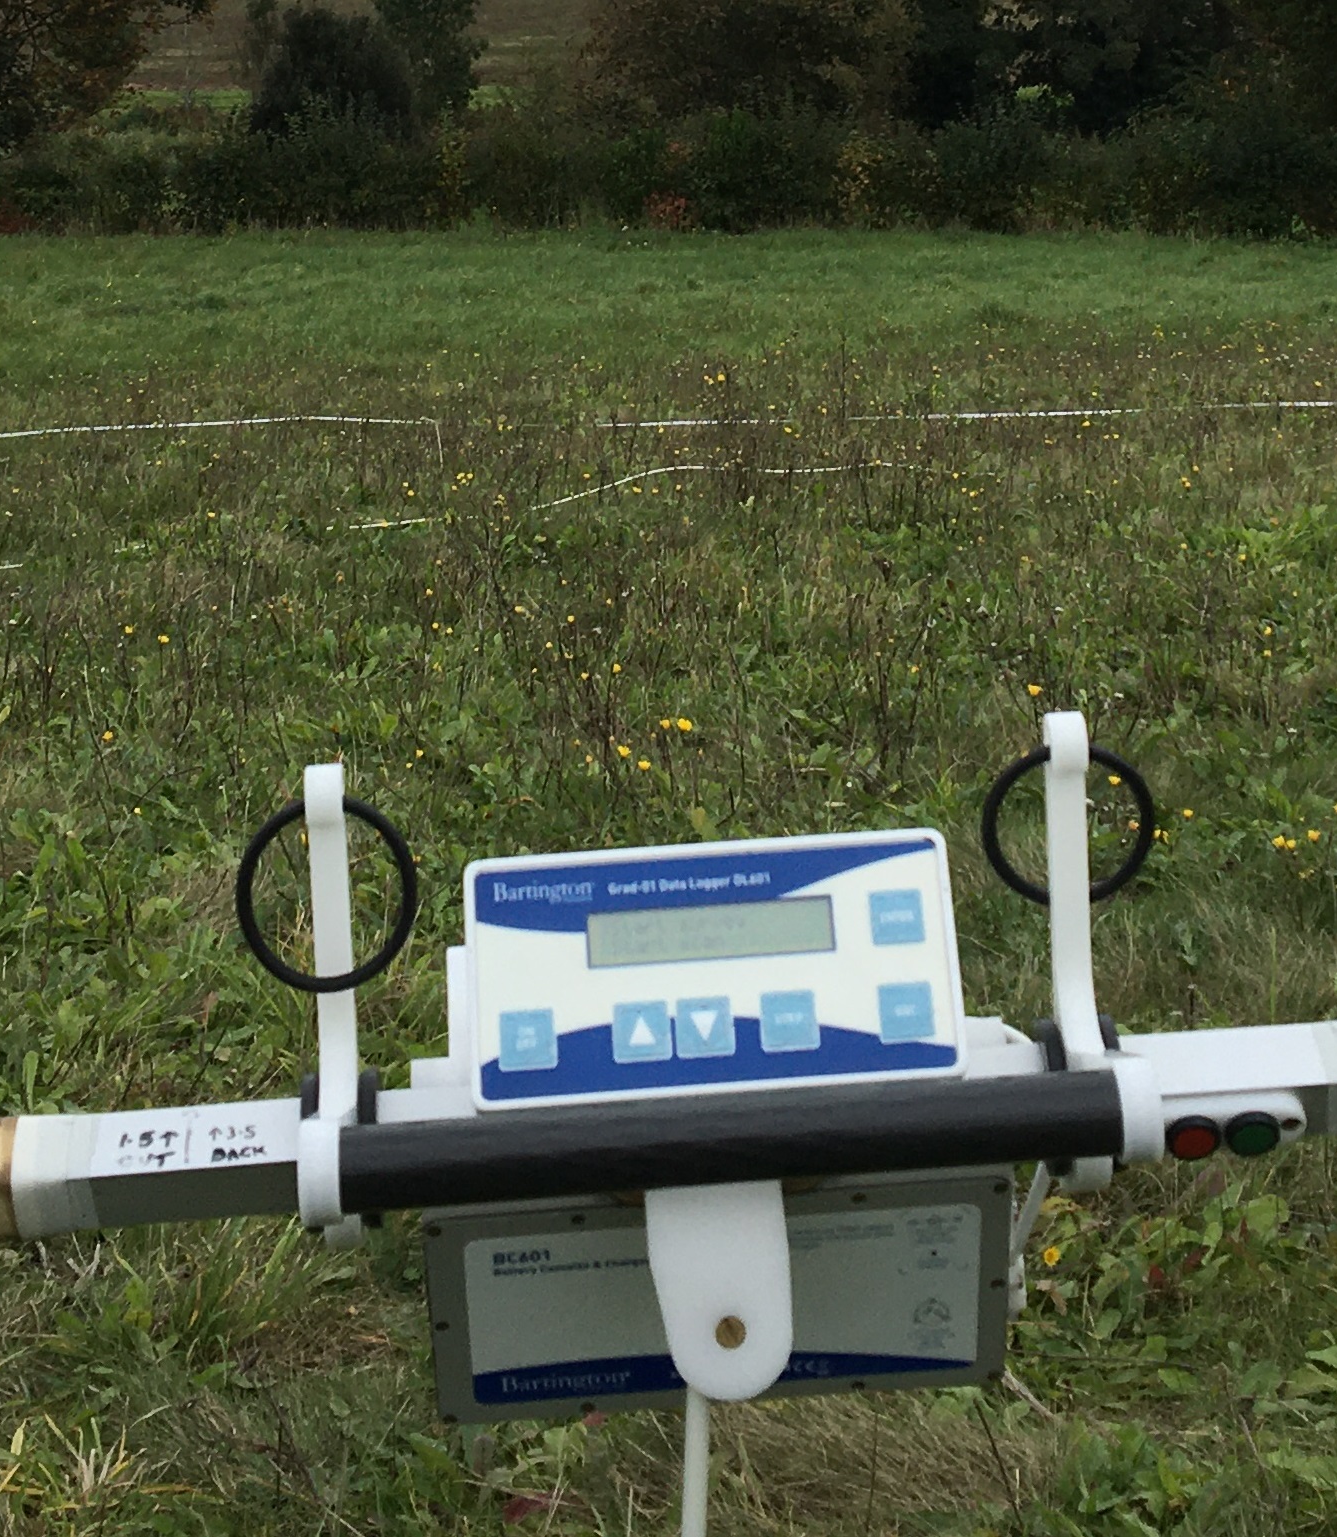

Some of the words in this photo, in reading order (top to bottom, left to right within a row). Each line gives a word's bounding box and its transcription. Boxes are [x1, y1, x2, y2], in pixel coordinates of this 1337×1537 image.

[658, 878, 687, 893] Data
[689, 876, 730, 892] Logger
[211, 1146, 267, 1163] BACK
[492, 1249, 551, 1266] BC601
